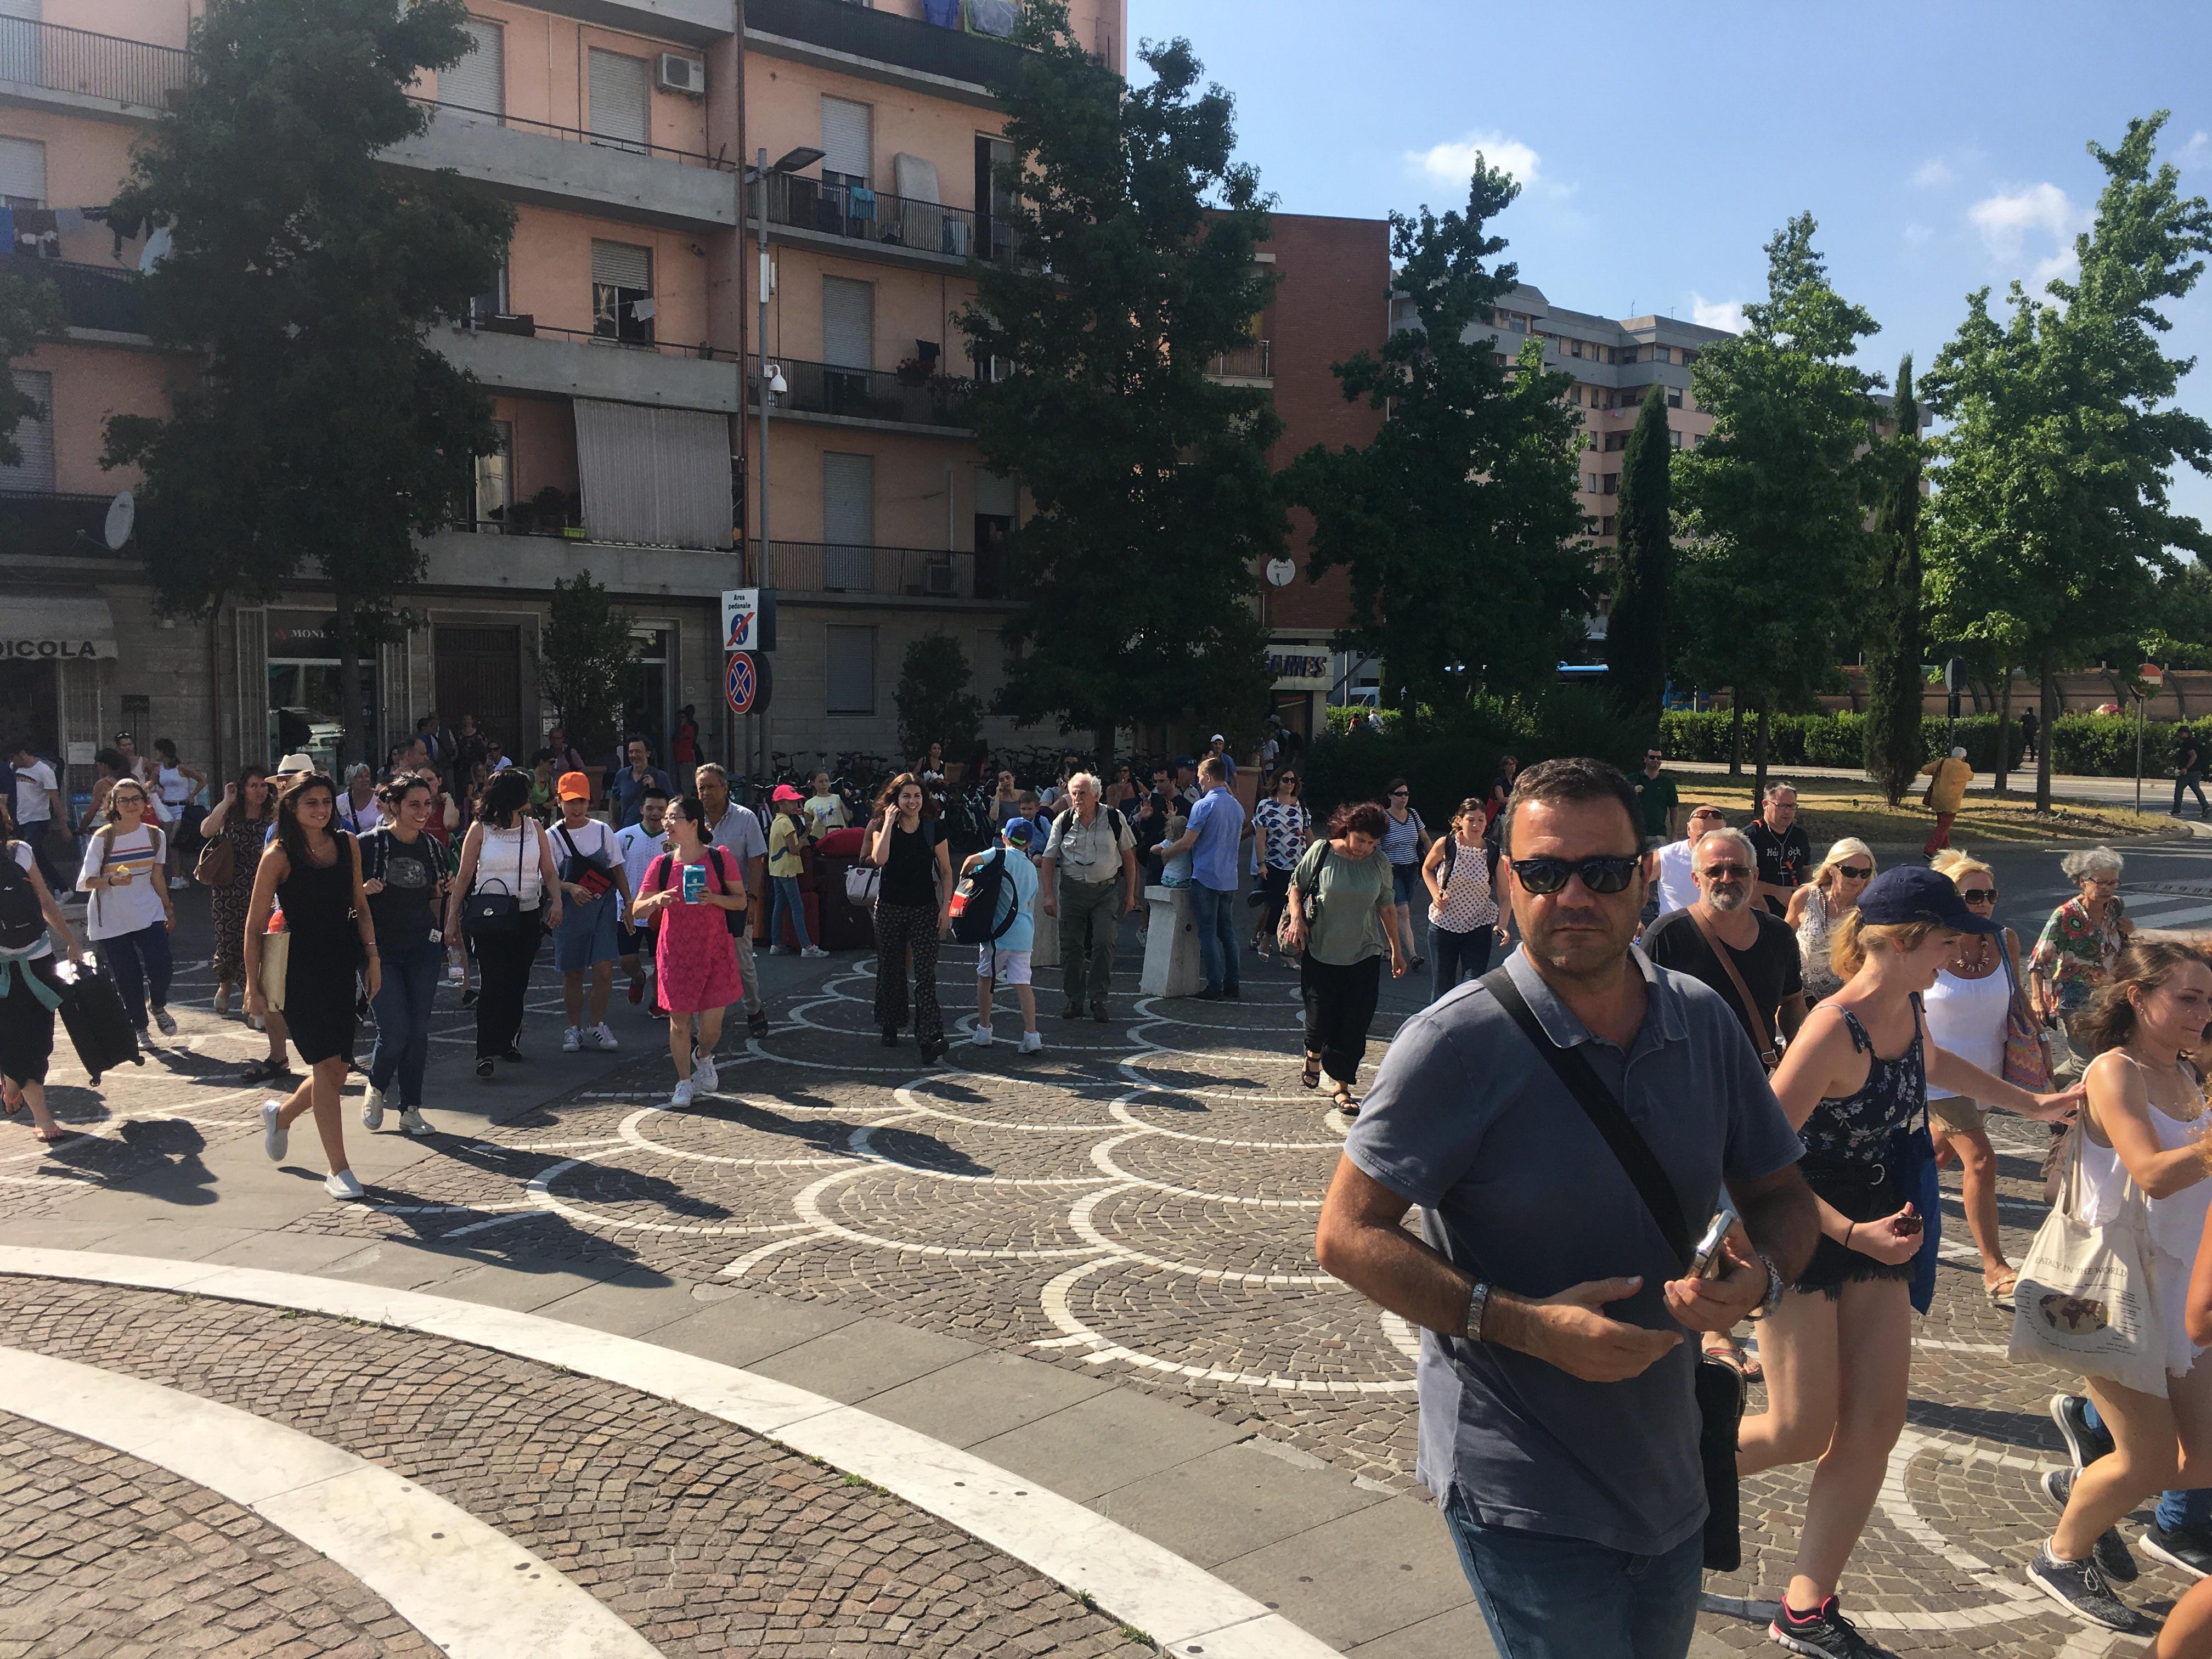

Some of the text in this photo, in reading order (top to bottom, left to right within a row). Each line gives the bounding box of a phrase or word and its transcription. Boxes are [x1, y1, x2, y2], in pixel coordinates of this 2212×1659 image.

[728, 602, 751, 611] pedonale
[0, 640, 97, 657] ICOLA
[1267, 654, 1327, 678] AMES
[625, 834, 635, 851] 7
[2035, 1256, 2062, 1269] EATALY
[2063, 1265, 2075, 1273] IN
[2095, 1266, 2128, 1278] WORLD
